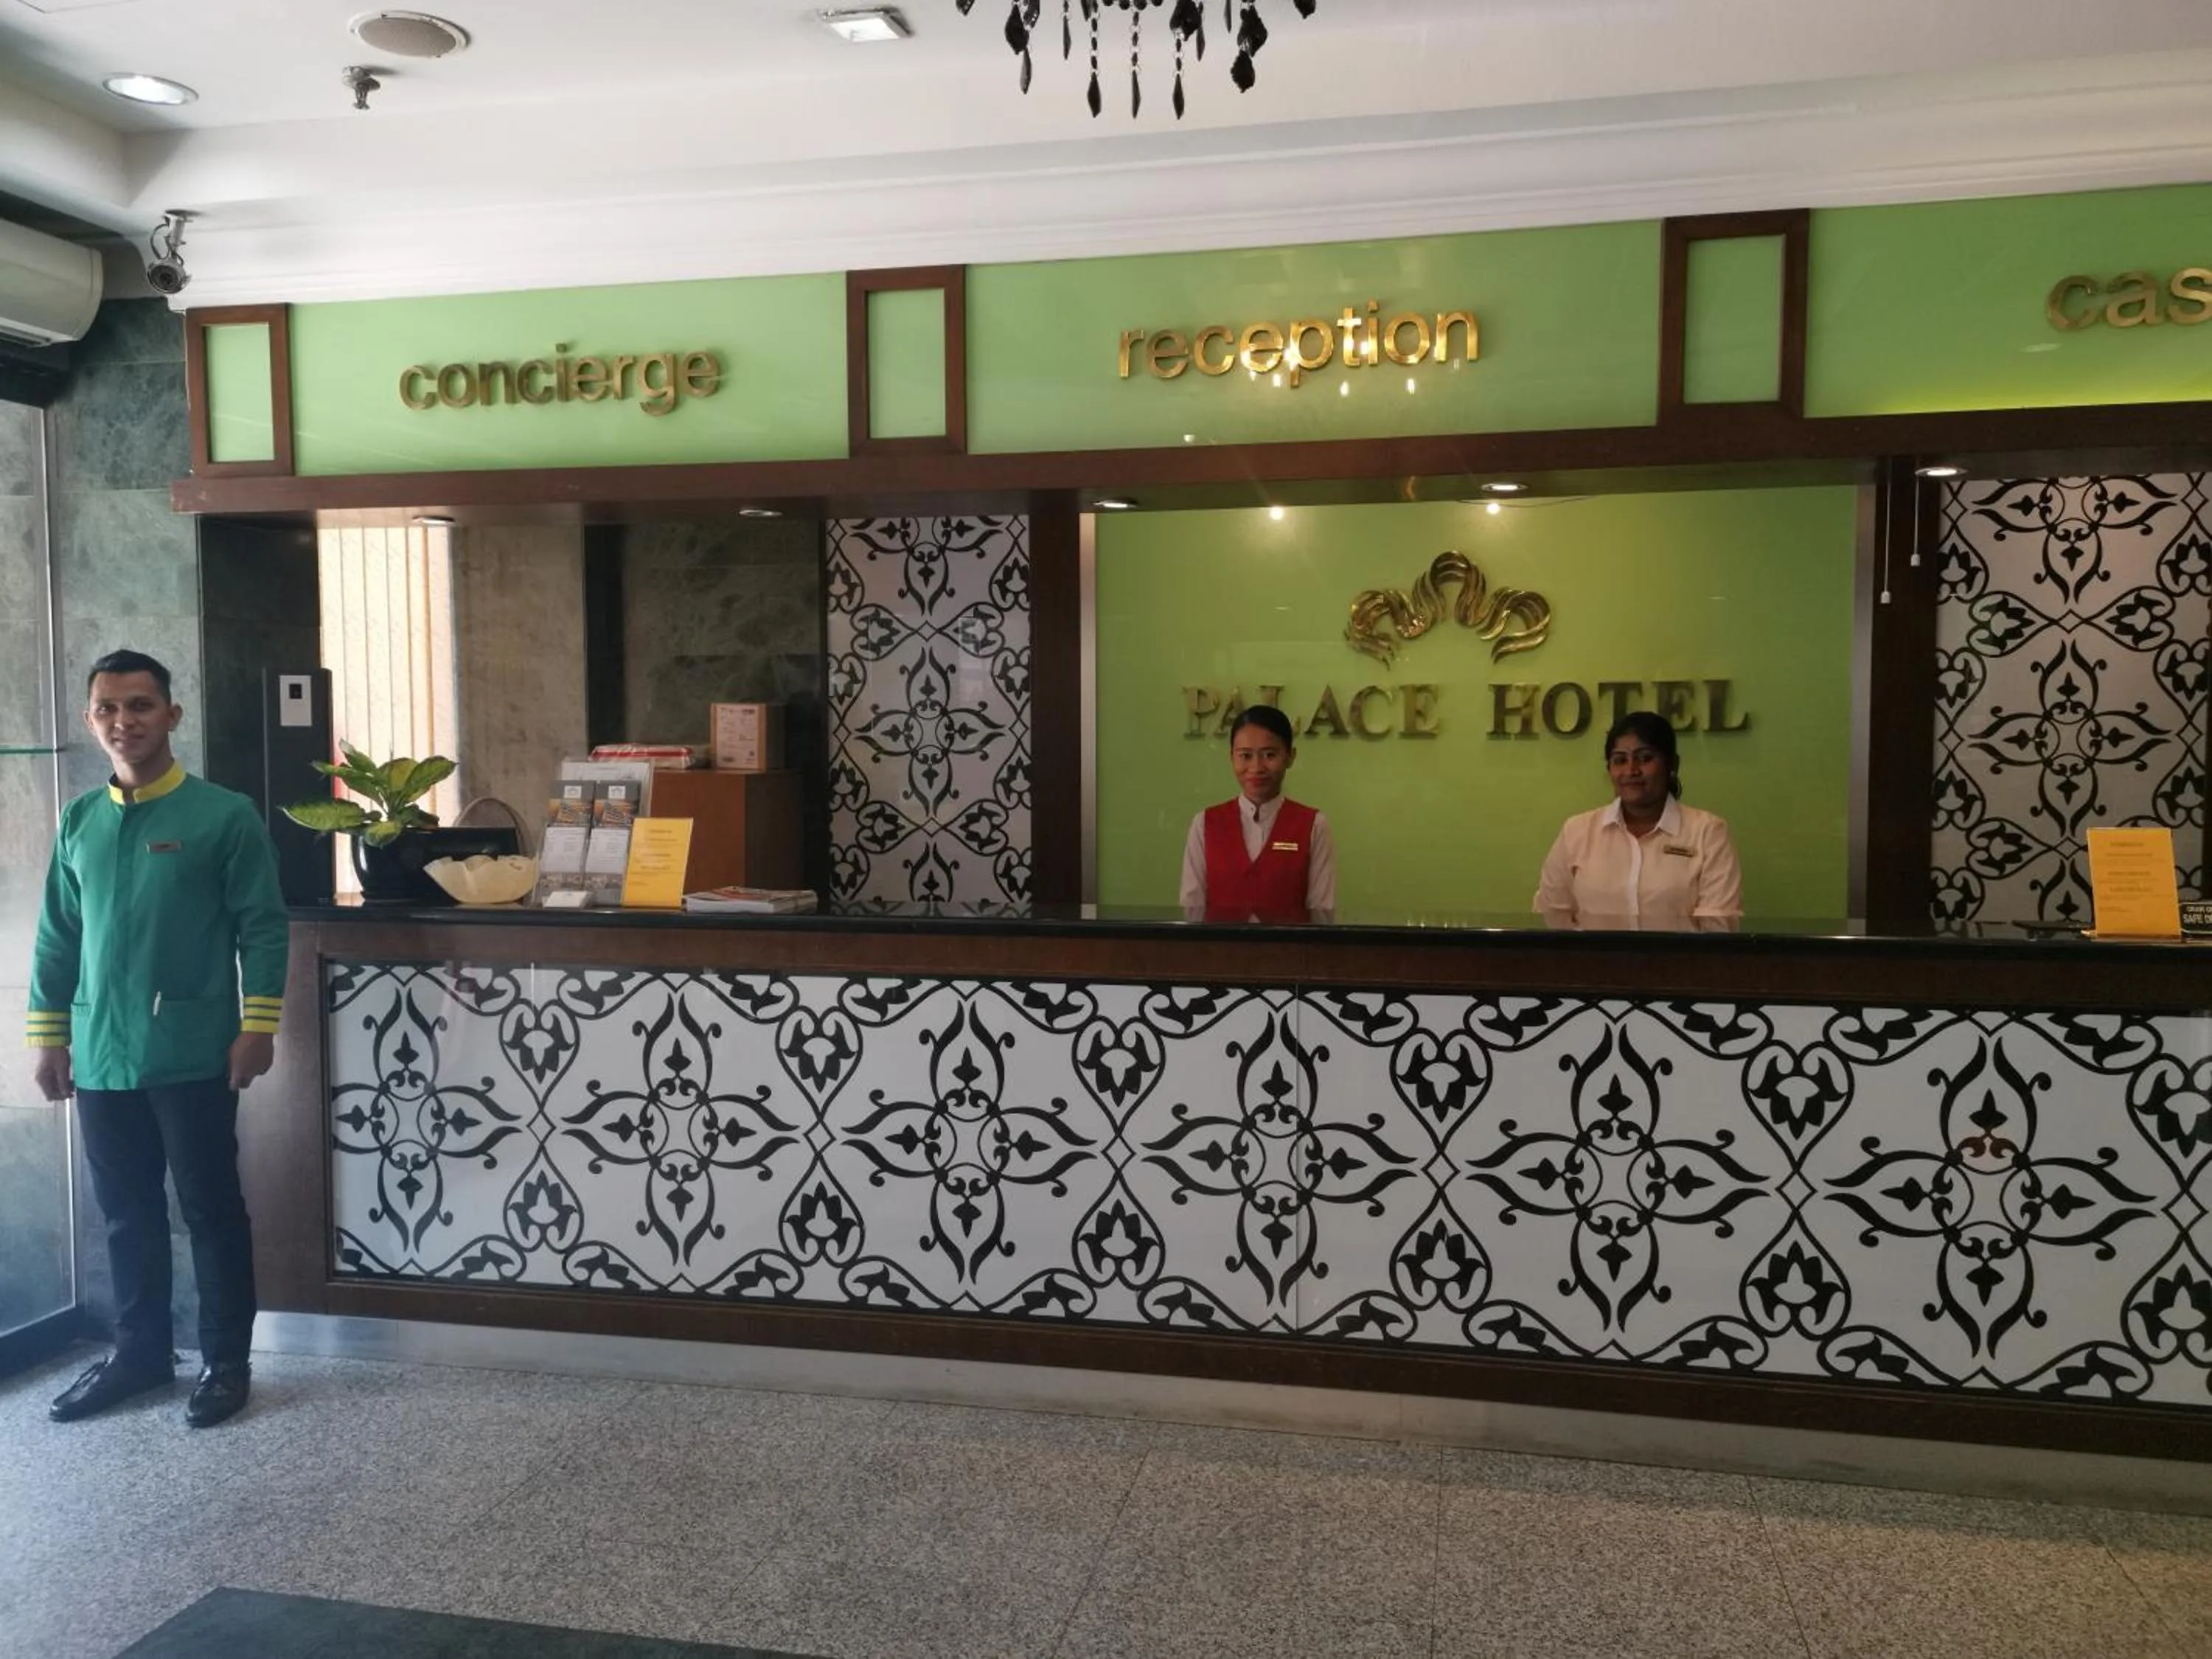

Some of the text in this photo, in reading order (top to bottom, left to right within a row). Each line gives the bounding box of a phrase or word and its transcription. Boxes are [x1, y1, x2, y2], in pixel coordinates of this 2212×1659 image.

[2048, 267, 2212, 330] cas
[1118, 299, 1480, 389] reception
[399, 342, 721, 417] concierge
[1486, 679, 1751, 741] HOTEL
